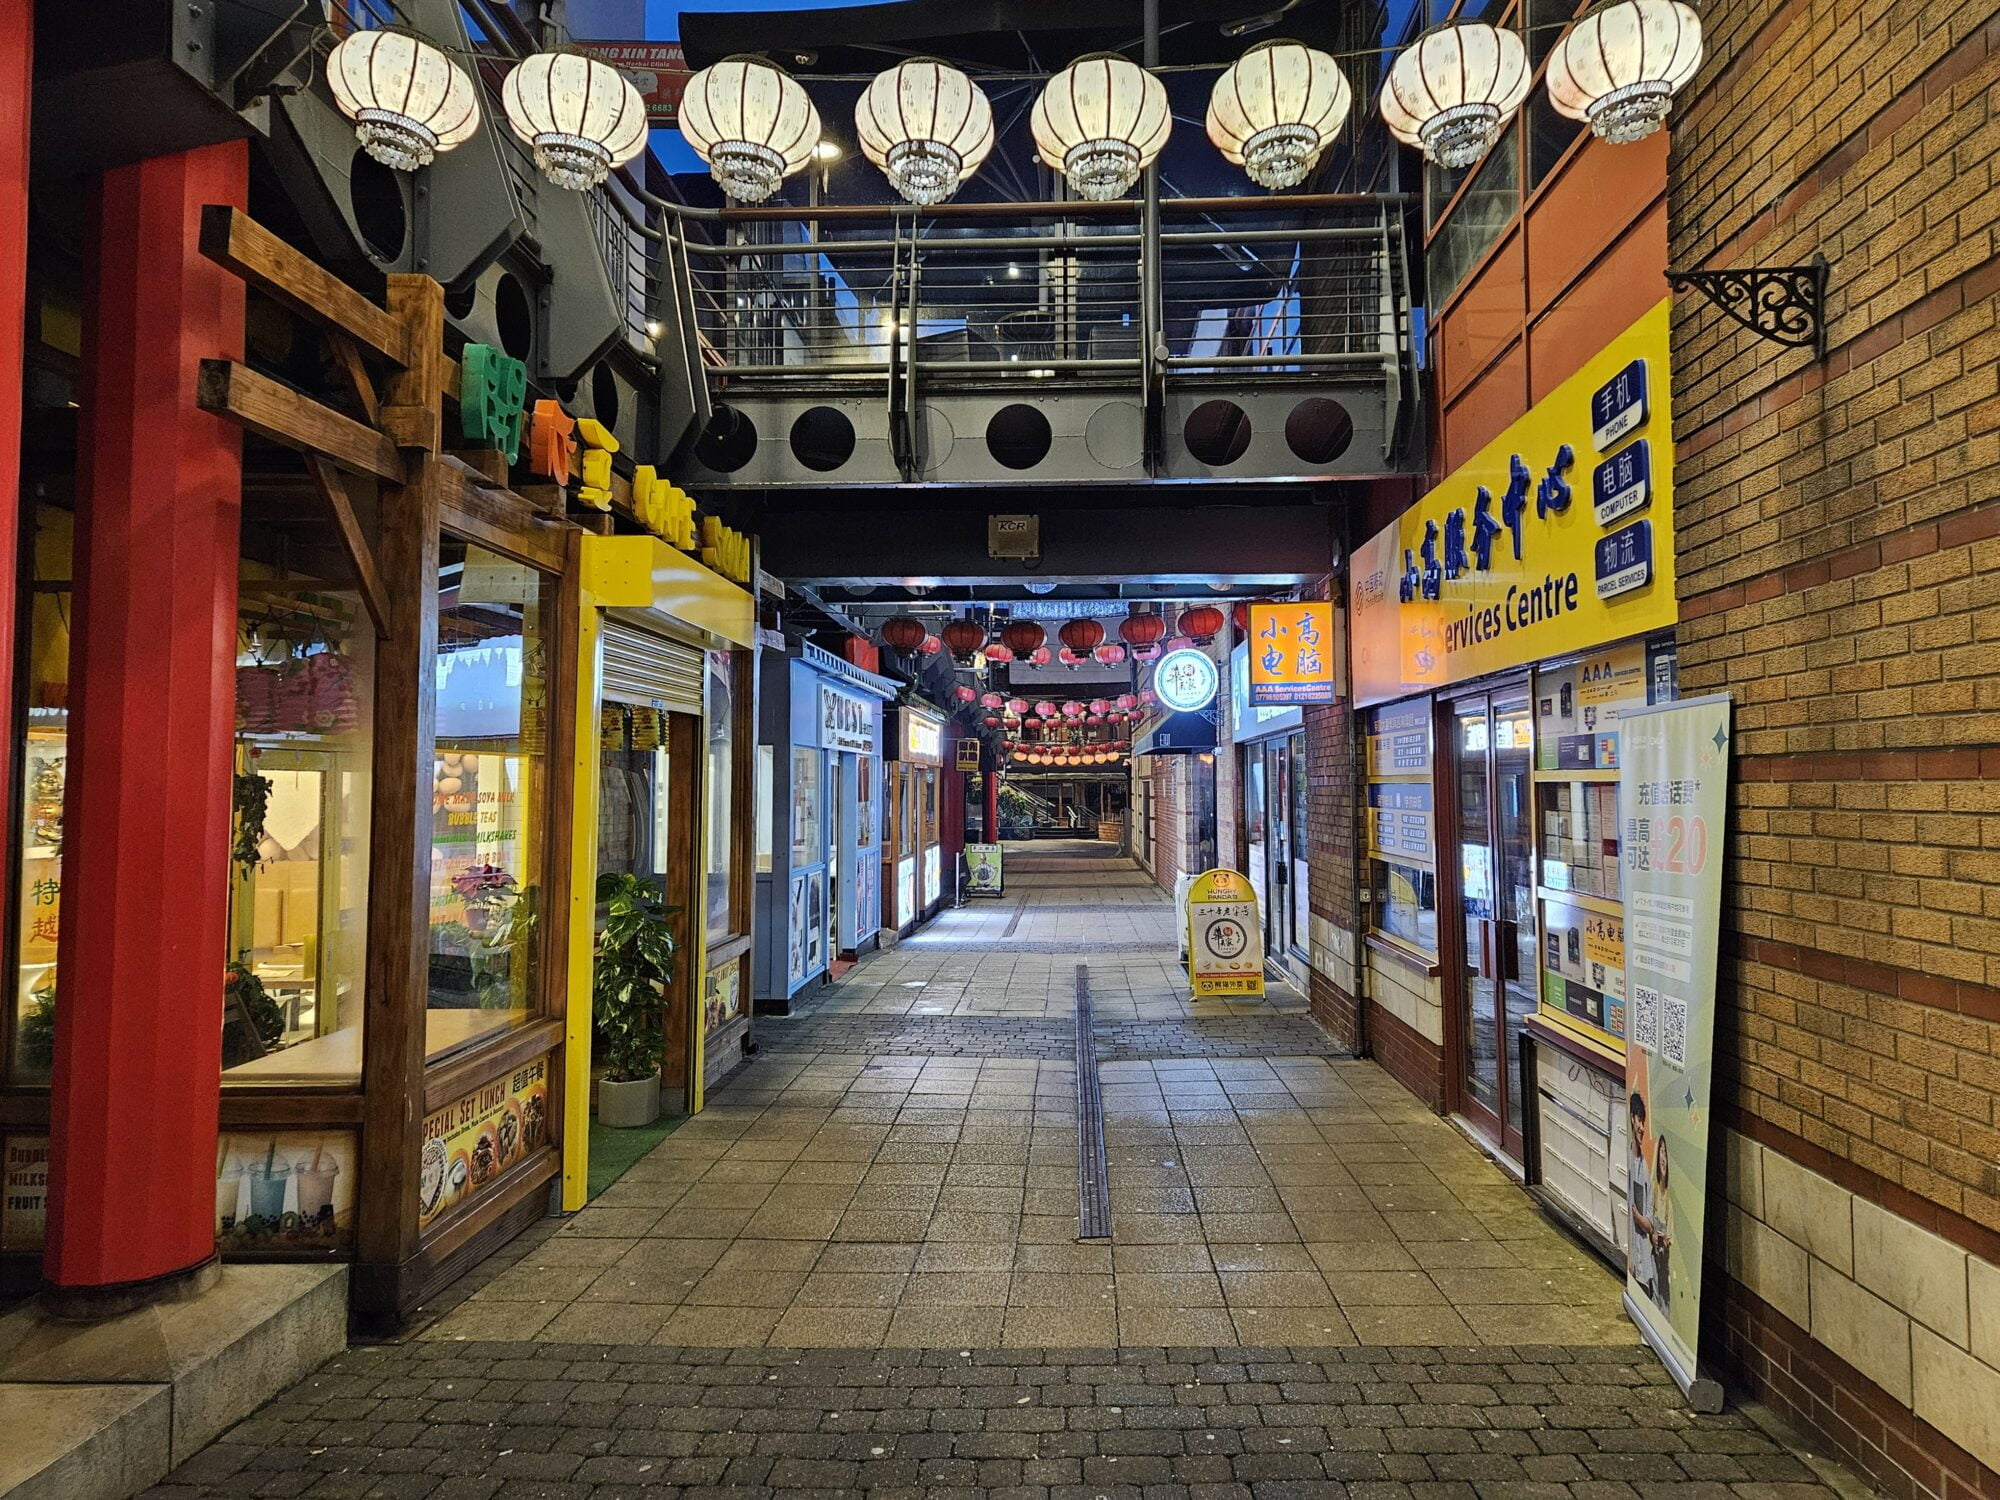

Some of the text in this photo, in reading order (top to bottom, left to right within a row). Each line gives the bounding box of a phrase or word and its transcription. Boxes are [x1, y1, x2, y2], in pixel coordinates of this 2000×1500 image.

[620, 48, 648, 59] XIN
[1600, 373, 1631, 420] 手机
[1605, 414, 1628, 440] PHONE
[1602, 452, 1633, 495] 电脑
[1600, 489, 1639, 520] COMPUTER
[633, 465, 750, 584] CAFE SOYA
[1603, 530, 1636, 572] 物流
[1597, 568, 1645, 595] PARCEL SERVICES
[1505, 572, 1578, 632] Centre
[1260, 612, 1320, 646] 小高
[1261, 643, 1322, 675] 电脑
[1582, 661, 1613, 683] AAA
[1255, 685, 1274, 693] AAA
[478, 791, 496, 804] SOYA
[480, 811, 498, 824] TEAS
[1627, 818, 1650, 844] 最高
[1627, 845, 1650, 872] 可达
[1651, 814, 1708, 876] £20
[512, 1060, 545, 1093] 超值午餐
[459, 1098, 476, 1125] SET
[479, 1081, 506, 1113] LUNCH
[8, 1196, 40, 1210] FRUIT
